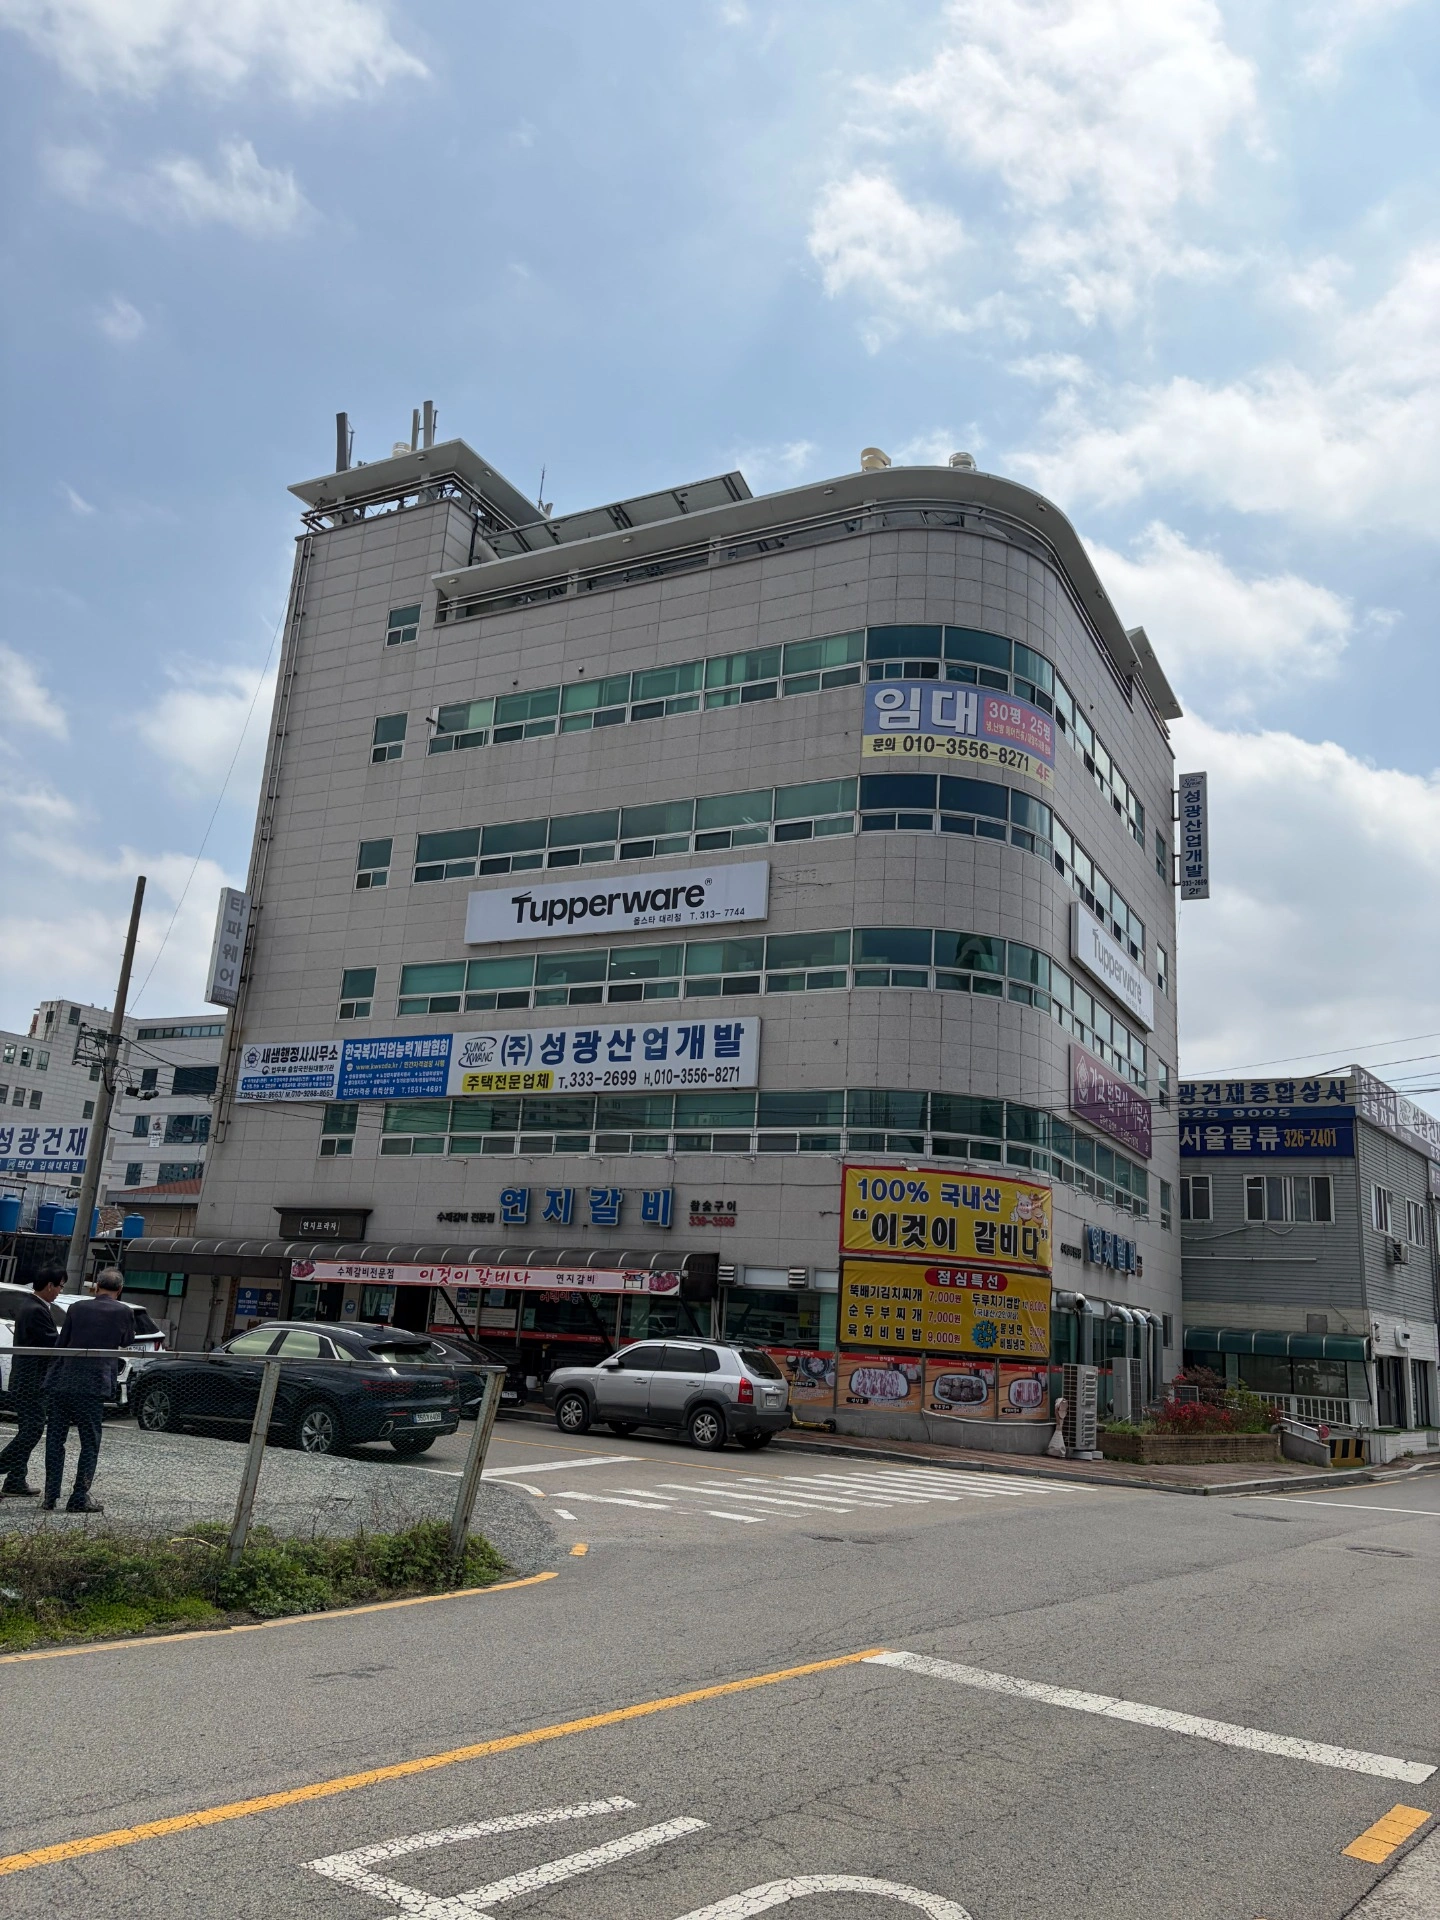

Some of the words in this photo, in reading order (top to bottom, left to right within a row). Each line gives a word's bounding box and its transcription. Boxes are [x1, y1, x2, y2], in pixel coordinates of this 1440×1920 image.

[874, 687, 979, 736] 임대
[1030, 716, 1051, 742] 25평
[873, 737, 895, 751] 문의
[903, 735, 1029, 772] 010-3556-8271
[1036, 762, 1050, 782] 4F
[1184, 789, 1203, 878] 성광산업개발
[1188, 887, 1202, 896] 2F
[511, 883, 705, 927] Tupperware
[633, 915, 656, 926] 올스타
[659, 912, 682, 924] 대리점
[219, 896, 246, 987] 타파웨어
[1092, 927, 1142, 1005] Tupperware
[261, 1044, 339, 1064] 새샘행정사사무소
[344, 1038, 450, 1060] 한국복지직업능력개발협회
[465, 1042, 487, 1056] SUNG
[501, 1033, 533, 1066] (주)
[540, 1022, 745, 1066] 성광산업개발
[466, 1052, 494, 1064] KWANG
[467, 1071, 550, 1091] 주택전문업체
[1361, 1096, 1397, 1133] 토목자재
[1180, 1125, 1280, 1151] 서울물류
[17, 1160, 35, 1170] 벽산
[39, 1161, 80, 1171] 김해대리점
[857, 1178, 930, 1204] 100%
[940, 1182, 1002, 1213] 국내산
[470, 1211, 495, 1223] 전문점
[500, 1186, 676, 1229] 연지갈비
[302, 1221, 337, 1231] 연지프라자
[336, 1265, 395, 1280] 수제갈비전문점
[419, 1267, 469, 1285] 이것이
[475, 1268, 532, 1286] 갈비다
[556, 1273, 596, 1285] 연지갈비
[937, 1270, 999, 1290] 점심특선
[849, 1284, 923, 1302] 뚝배기김치찌개
[928, 1290, 962, 1304] 7,000원
[971, 1293, 1021, 1310] 두루치기쌈밥
[928, 1311, 961, 1324] 7,000원
[927, 1331, 961, 1344] 9,000원
[1000, 1323, 1023, 1336] 물냉면
[999, 1338, 1026, 1351] 비빔냉면
